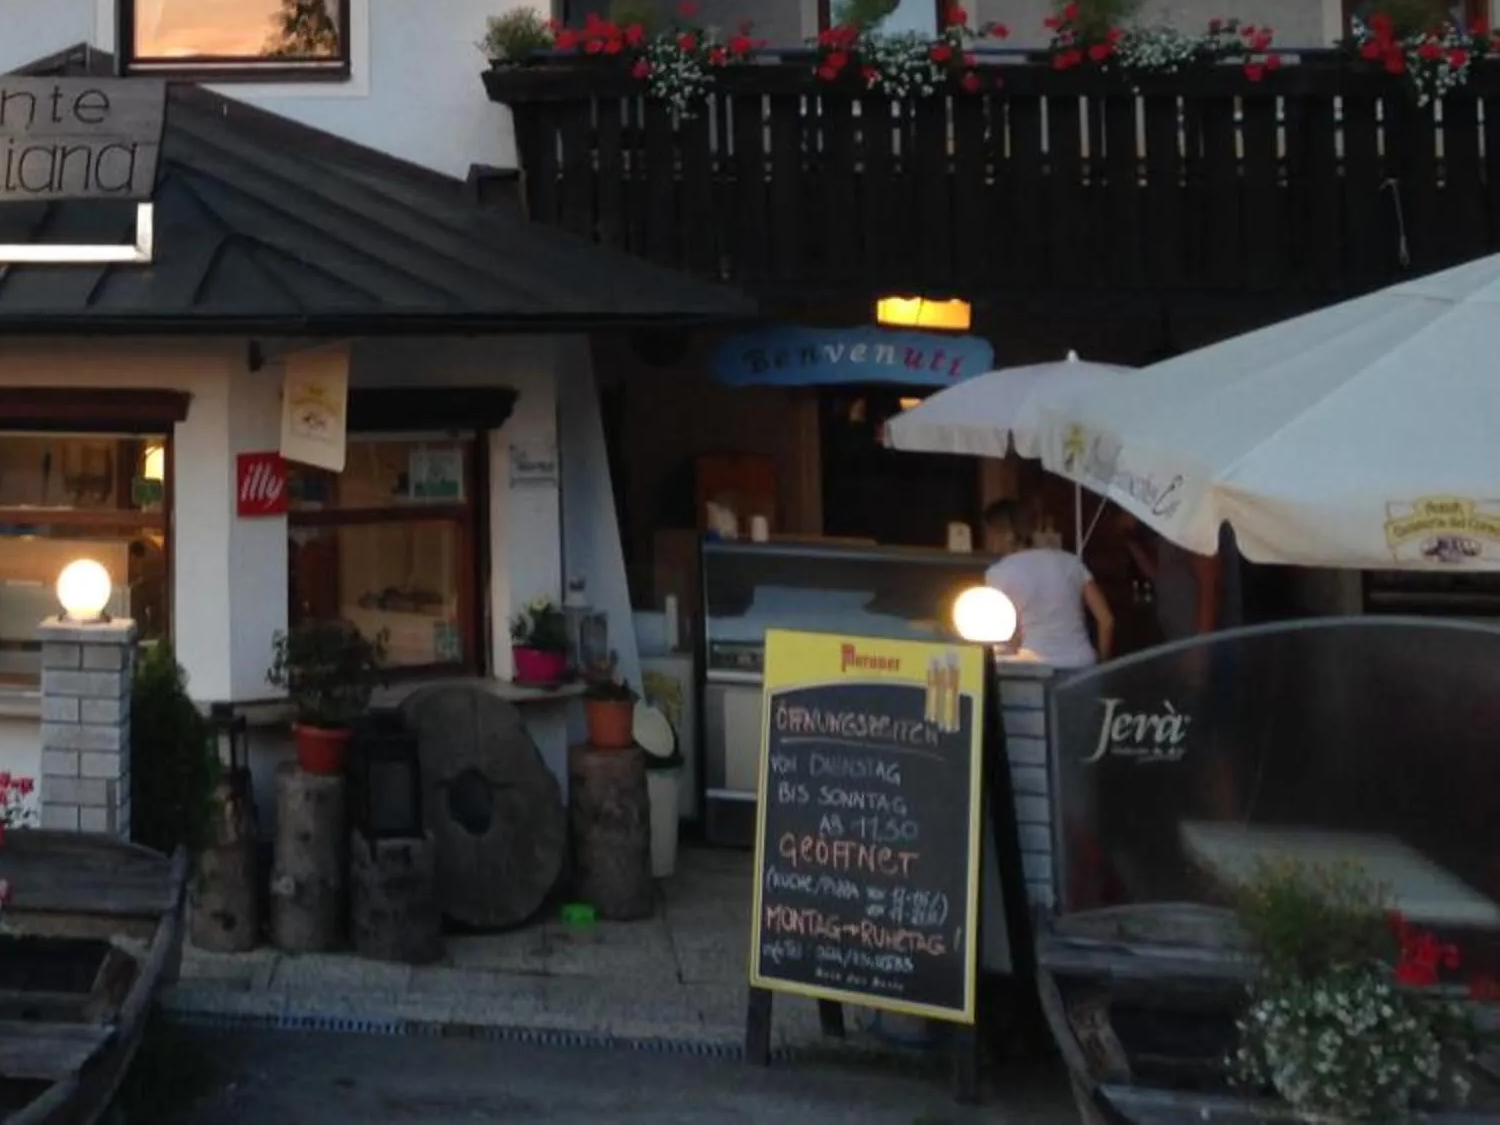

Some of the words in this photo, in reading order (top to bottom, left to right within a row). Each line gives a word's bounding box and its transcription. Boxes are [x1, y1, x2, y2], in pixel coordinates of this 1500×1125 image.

[740, 340, 967, 378] Benvenuti
[241, 462, 284, 509] illy
[778, 780, 810, 804] BIS
[819, 785, 908, 817] SONNTAG
[766, 903, 842, 943] MONTAG
